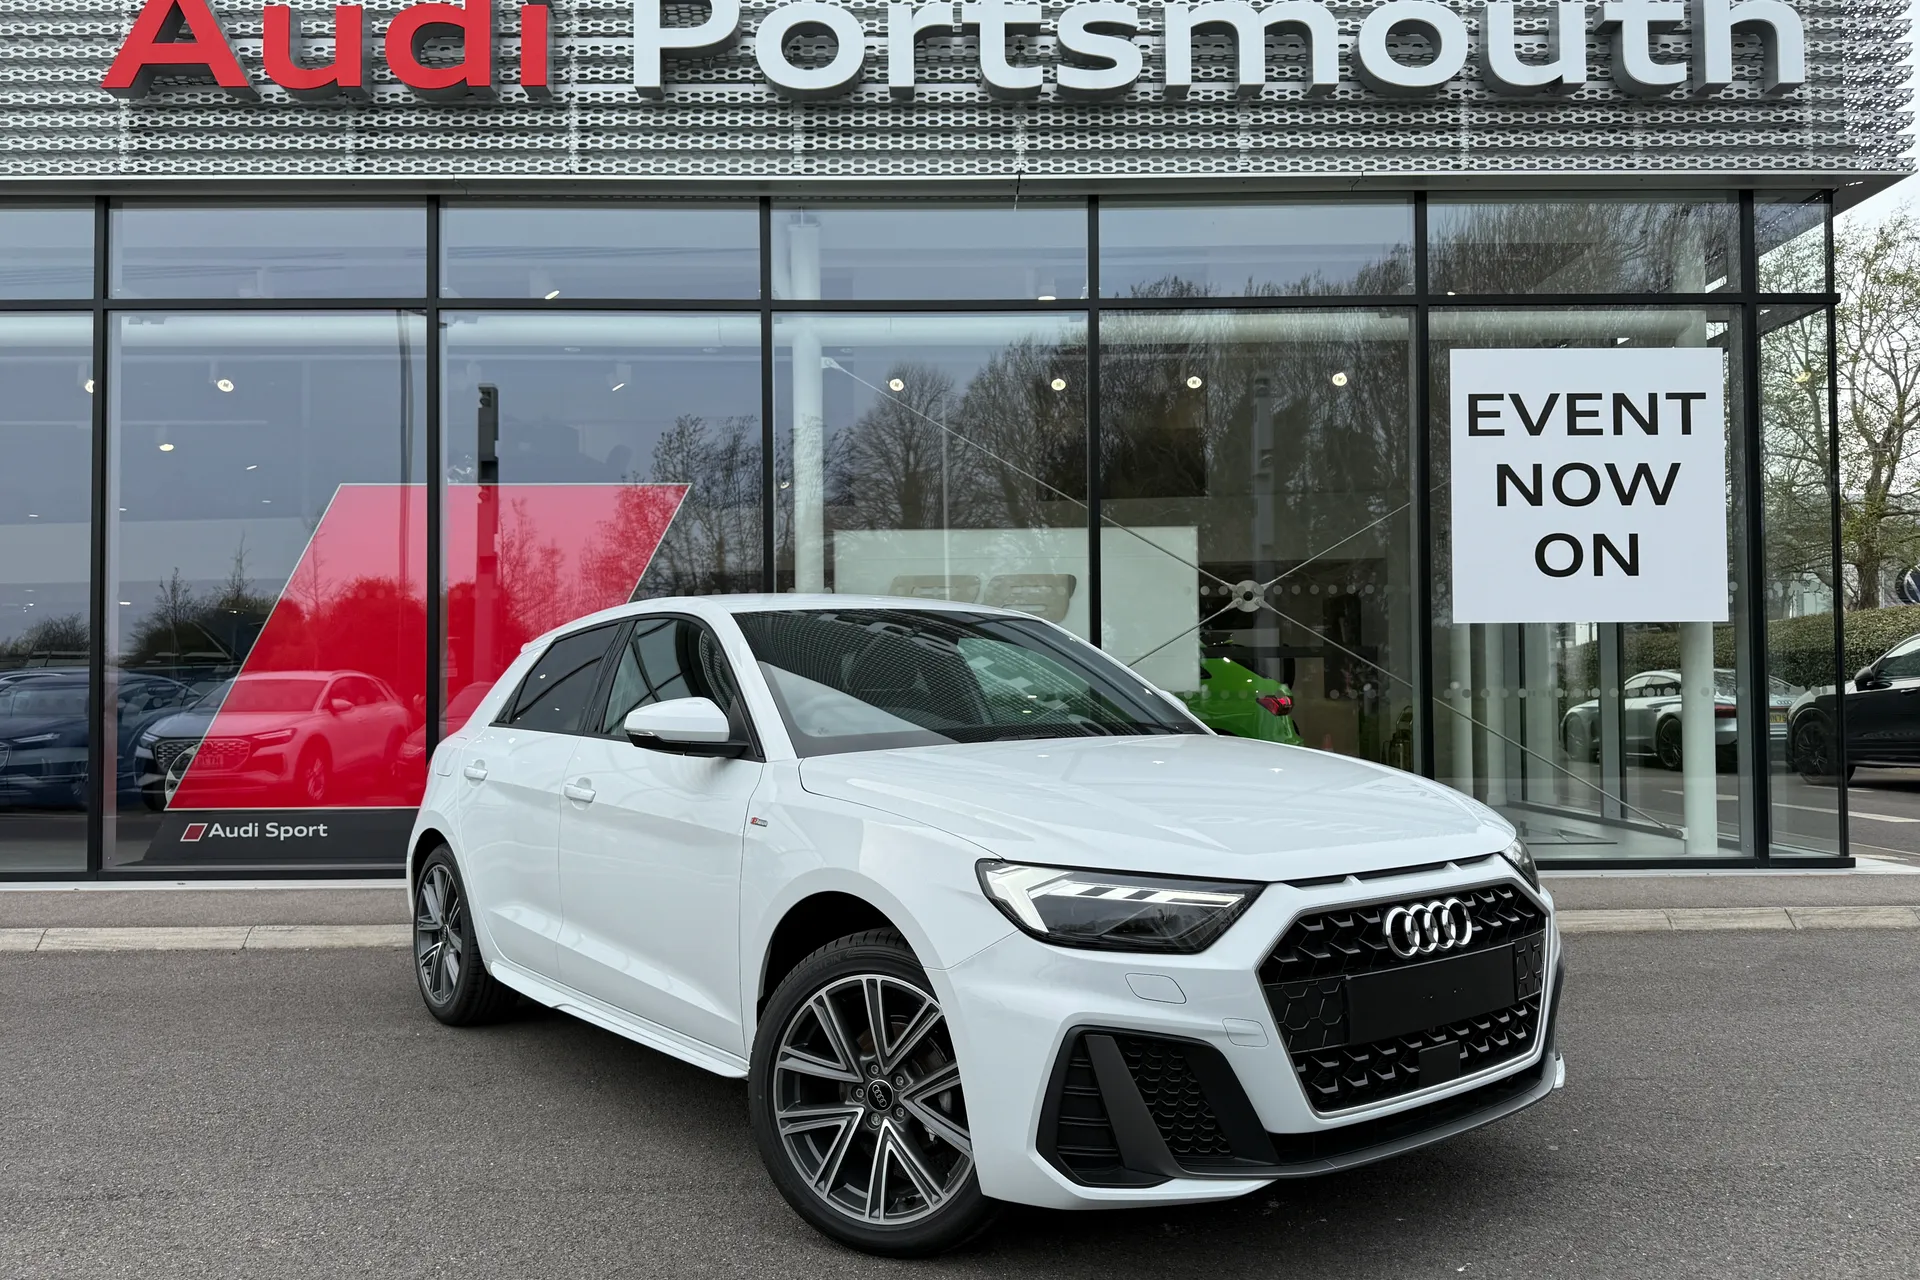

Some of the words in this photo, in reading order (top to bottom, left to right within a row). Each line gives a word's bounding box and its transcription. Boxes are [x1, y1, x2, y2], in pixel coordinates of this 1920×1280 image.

[101, 0, 549, 90] Audi
[633, 0, 1806, 91] Portsmouth
[1467, 392, 1707, 437] EVENT
[1496, 462, 1682, 508] NOW
[1534, 532, 1640, 578] ON
[208, 822, 259, 838] Audi
[265, 822, 328, 841] Sport
